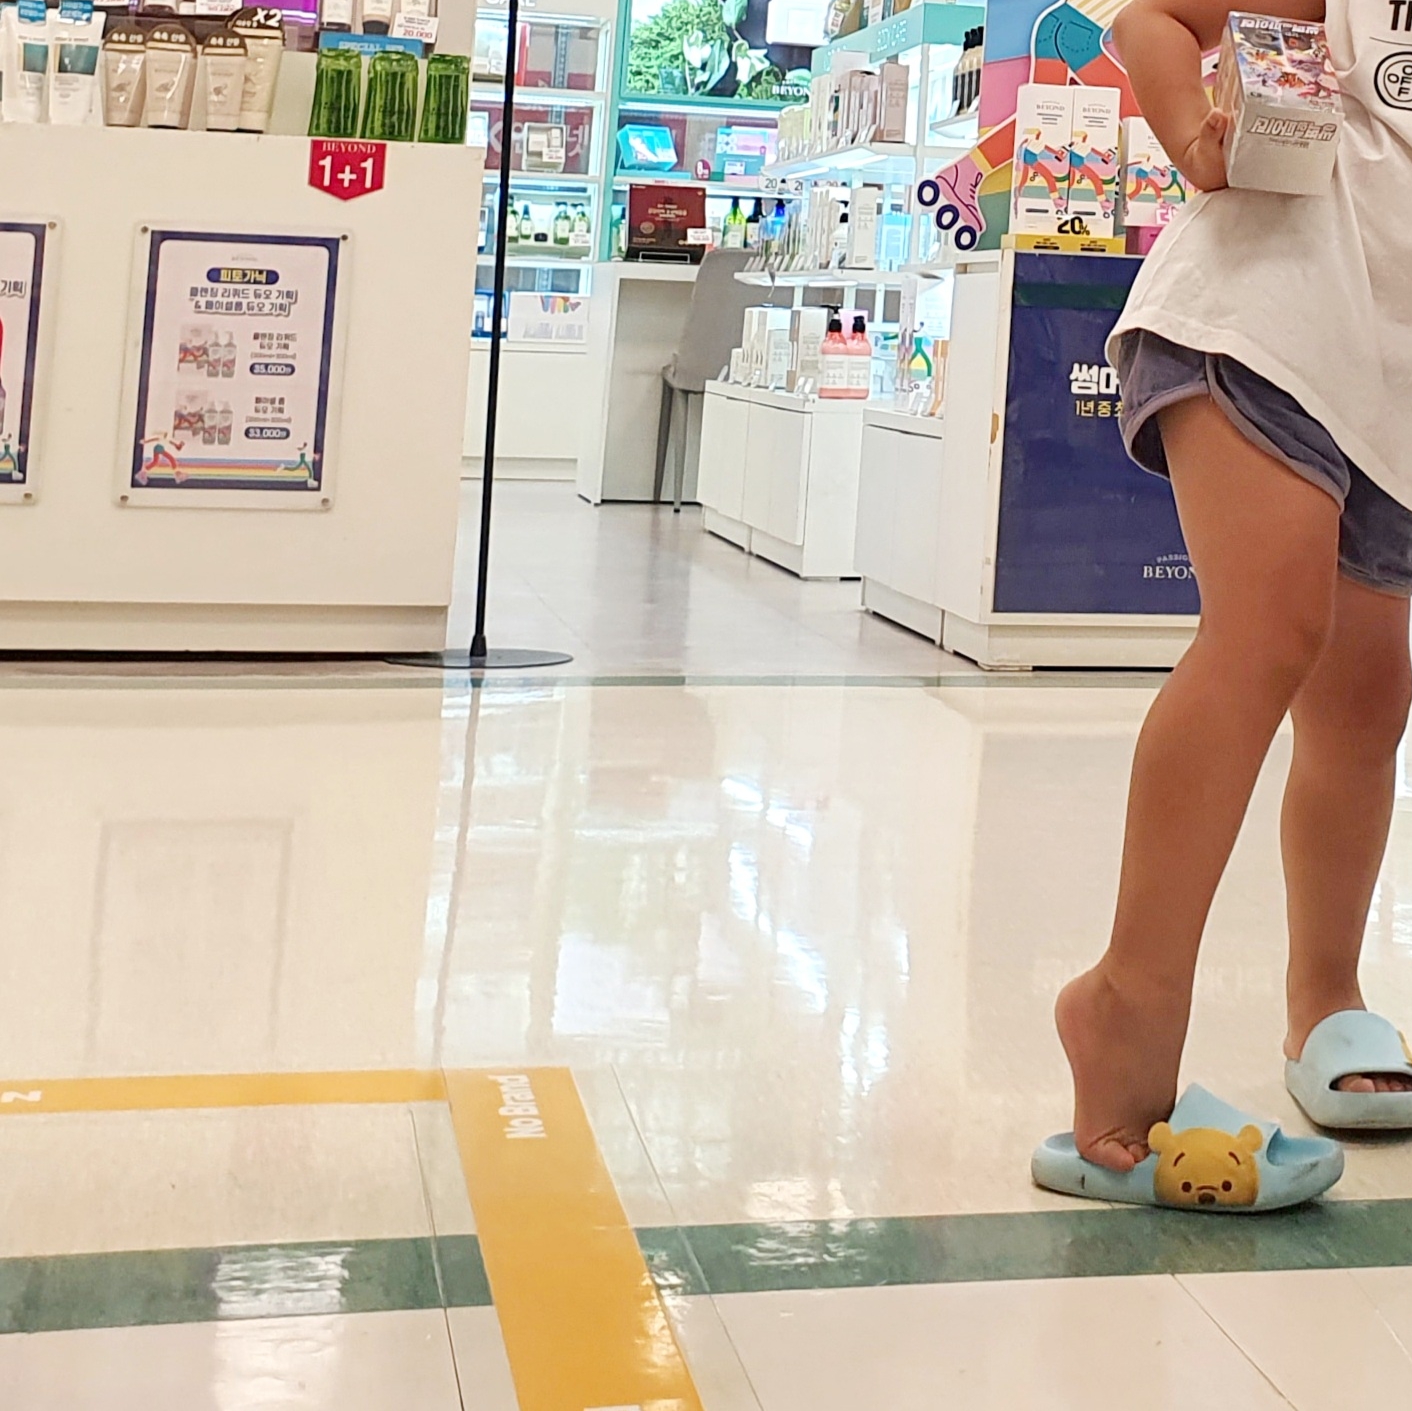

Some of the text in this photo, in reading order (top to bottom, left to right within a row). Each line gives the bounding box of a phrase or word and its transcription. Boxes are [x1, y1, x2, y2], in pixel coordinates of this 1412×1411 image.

[322, 141, 377, 154] BEYOND
[318, 155, 375, 189] 1+1
[1075, 399, 1095, 417] 1년
[1097, 400, 1112, 418] 중
[488, 1074, 547, 1140] No Brand
